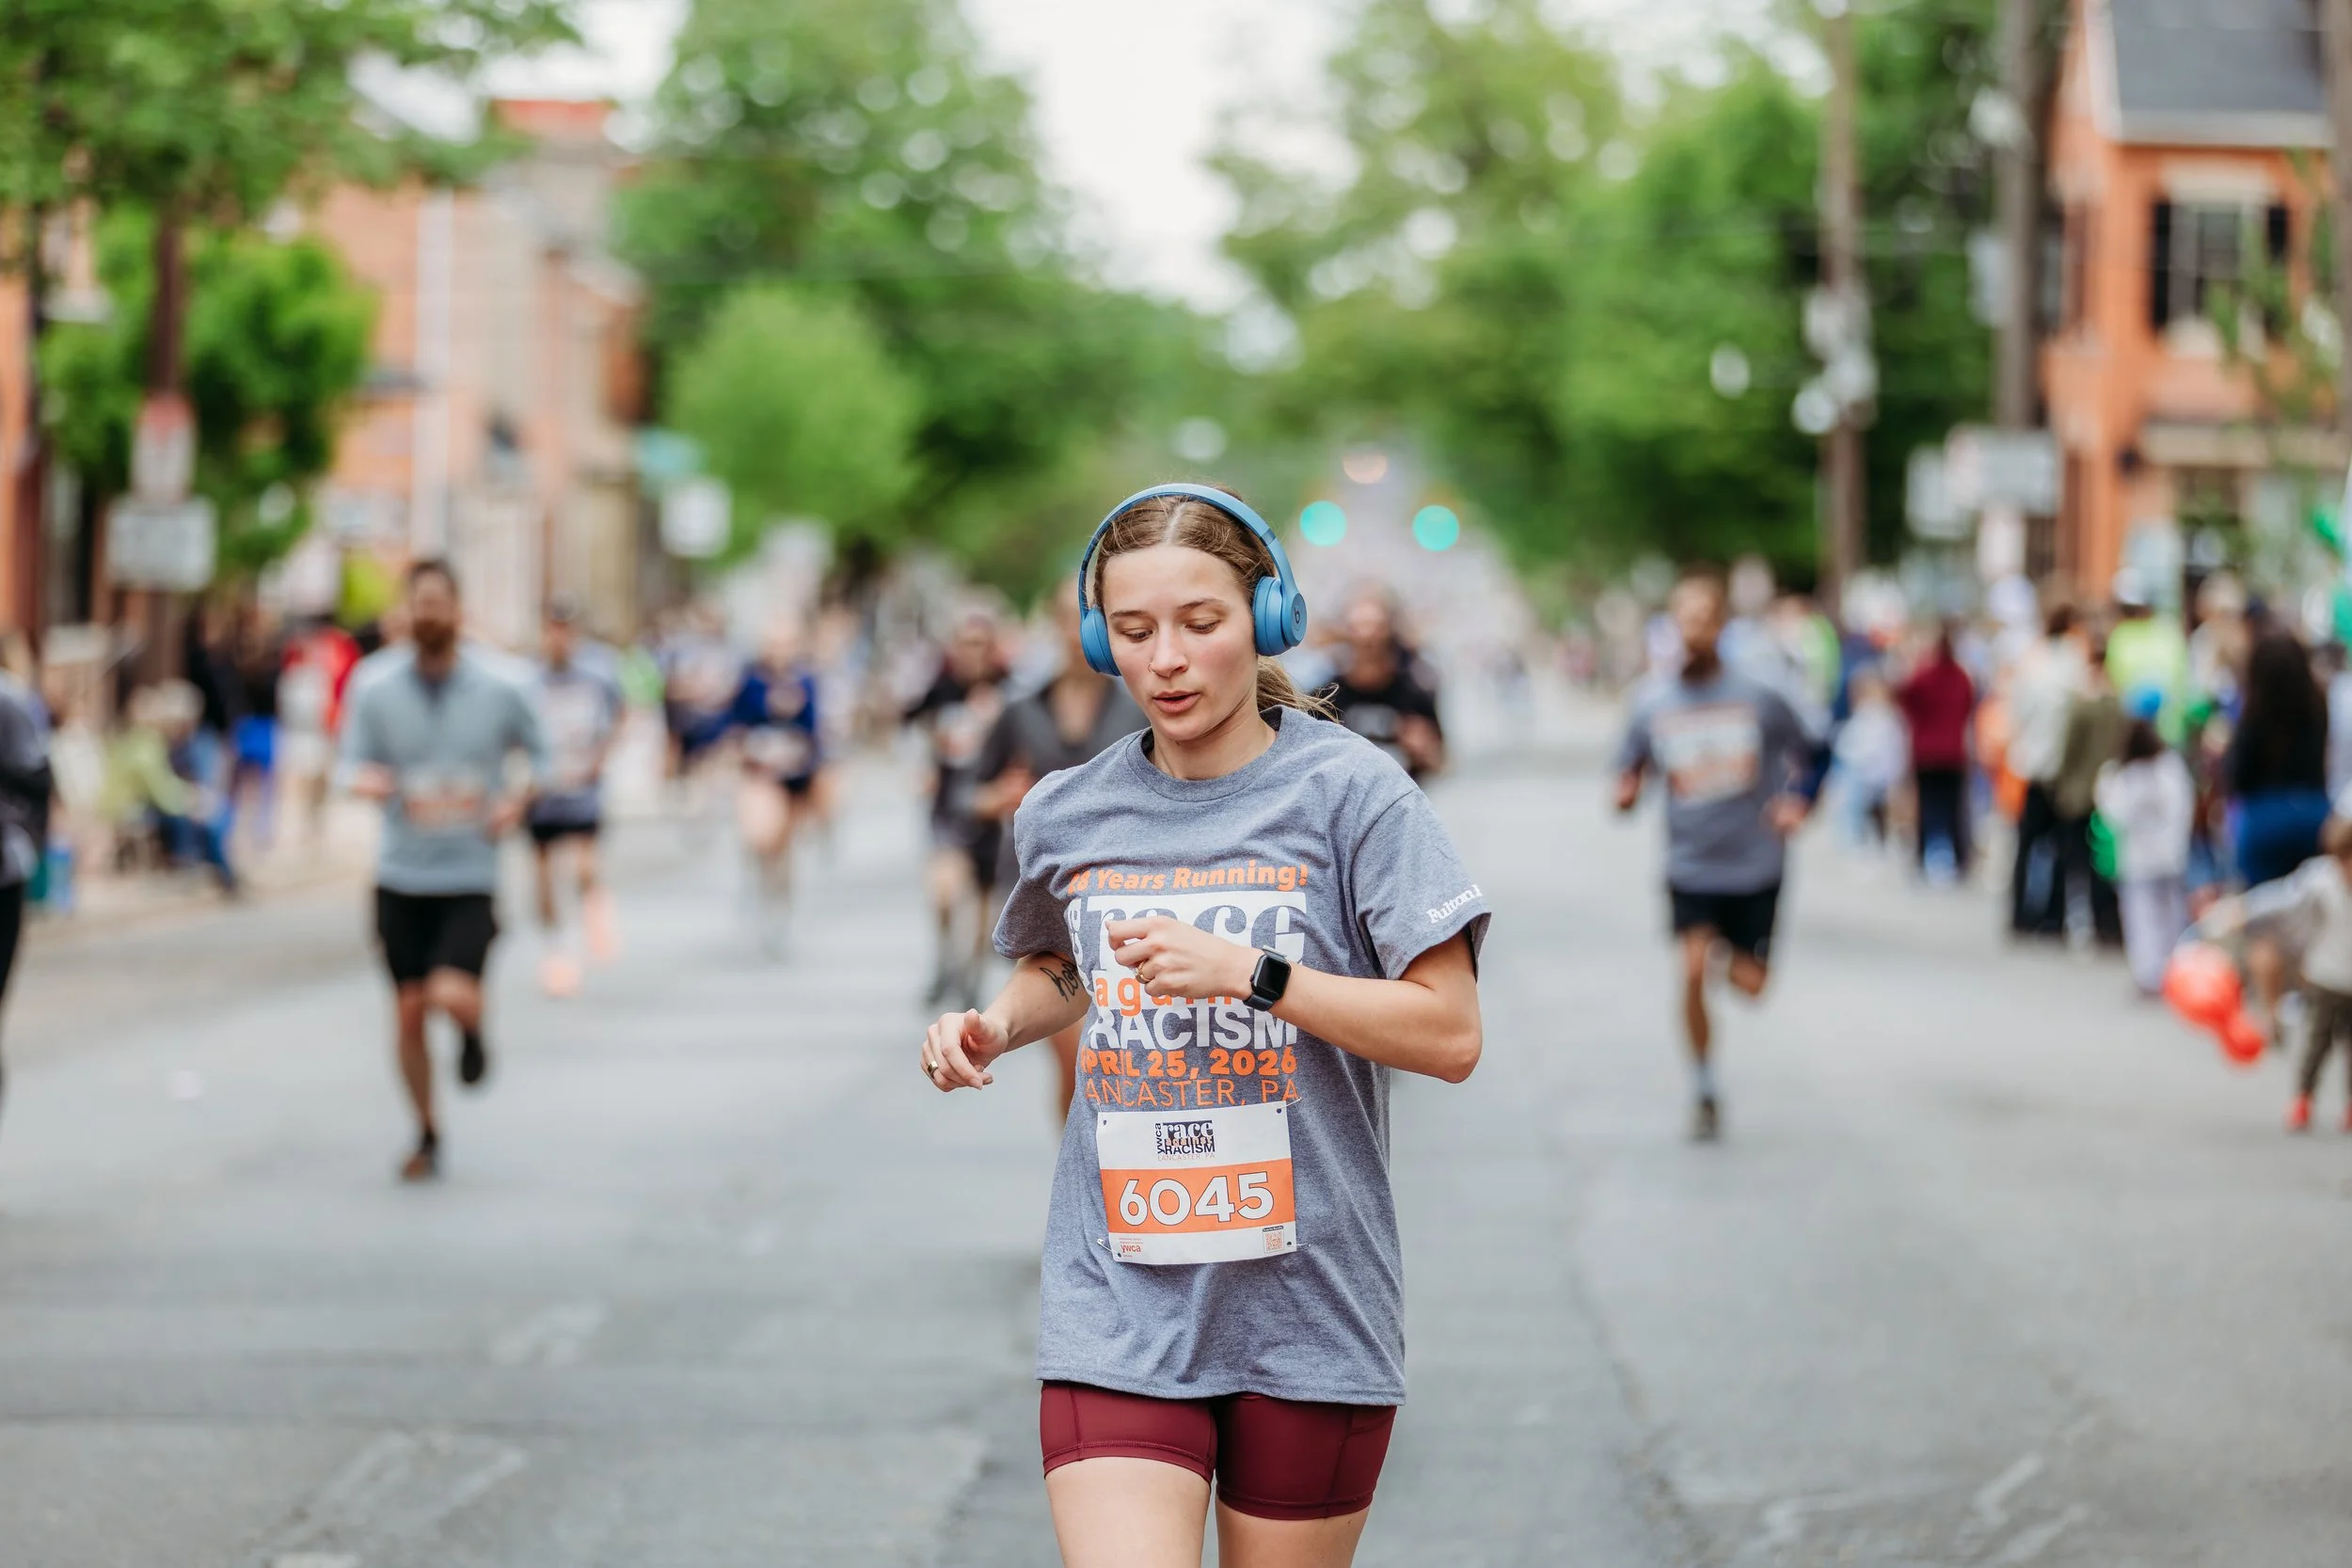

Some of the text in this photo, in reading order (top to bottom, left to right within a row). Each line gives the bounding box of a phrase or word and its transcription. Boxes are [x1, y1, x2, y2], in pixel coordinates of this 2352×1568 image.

[1096, 869, 1166, 891] Years
[1173, 860, 1309, 891] Running!
[1089, 1005, 1297, 1050] RACISM
[1147, 1050, 1199, 1079] 25,
[1209, 1046, 1297, 1076] 2026
[1085, 1078, 1300, 1106] ANCASTER, PA
[1155, 1122, 1165, 1154] ywca
[1162, 1120, 1215, 1139] race
[1165, 1143, 1216, 1155] RACISM
[1119, 1171, 1275, 1227] 6045
[1120, 1244, 1141, 1253] ywca
